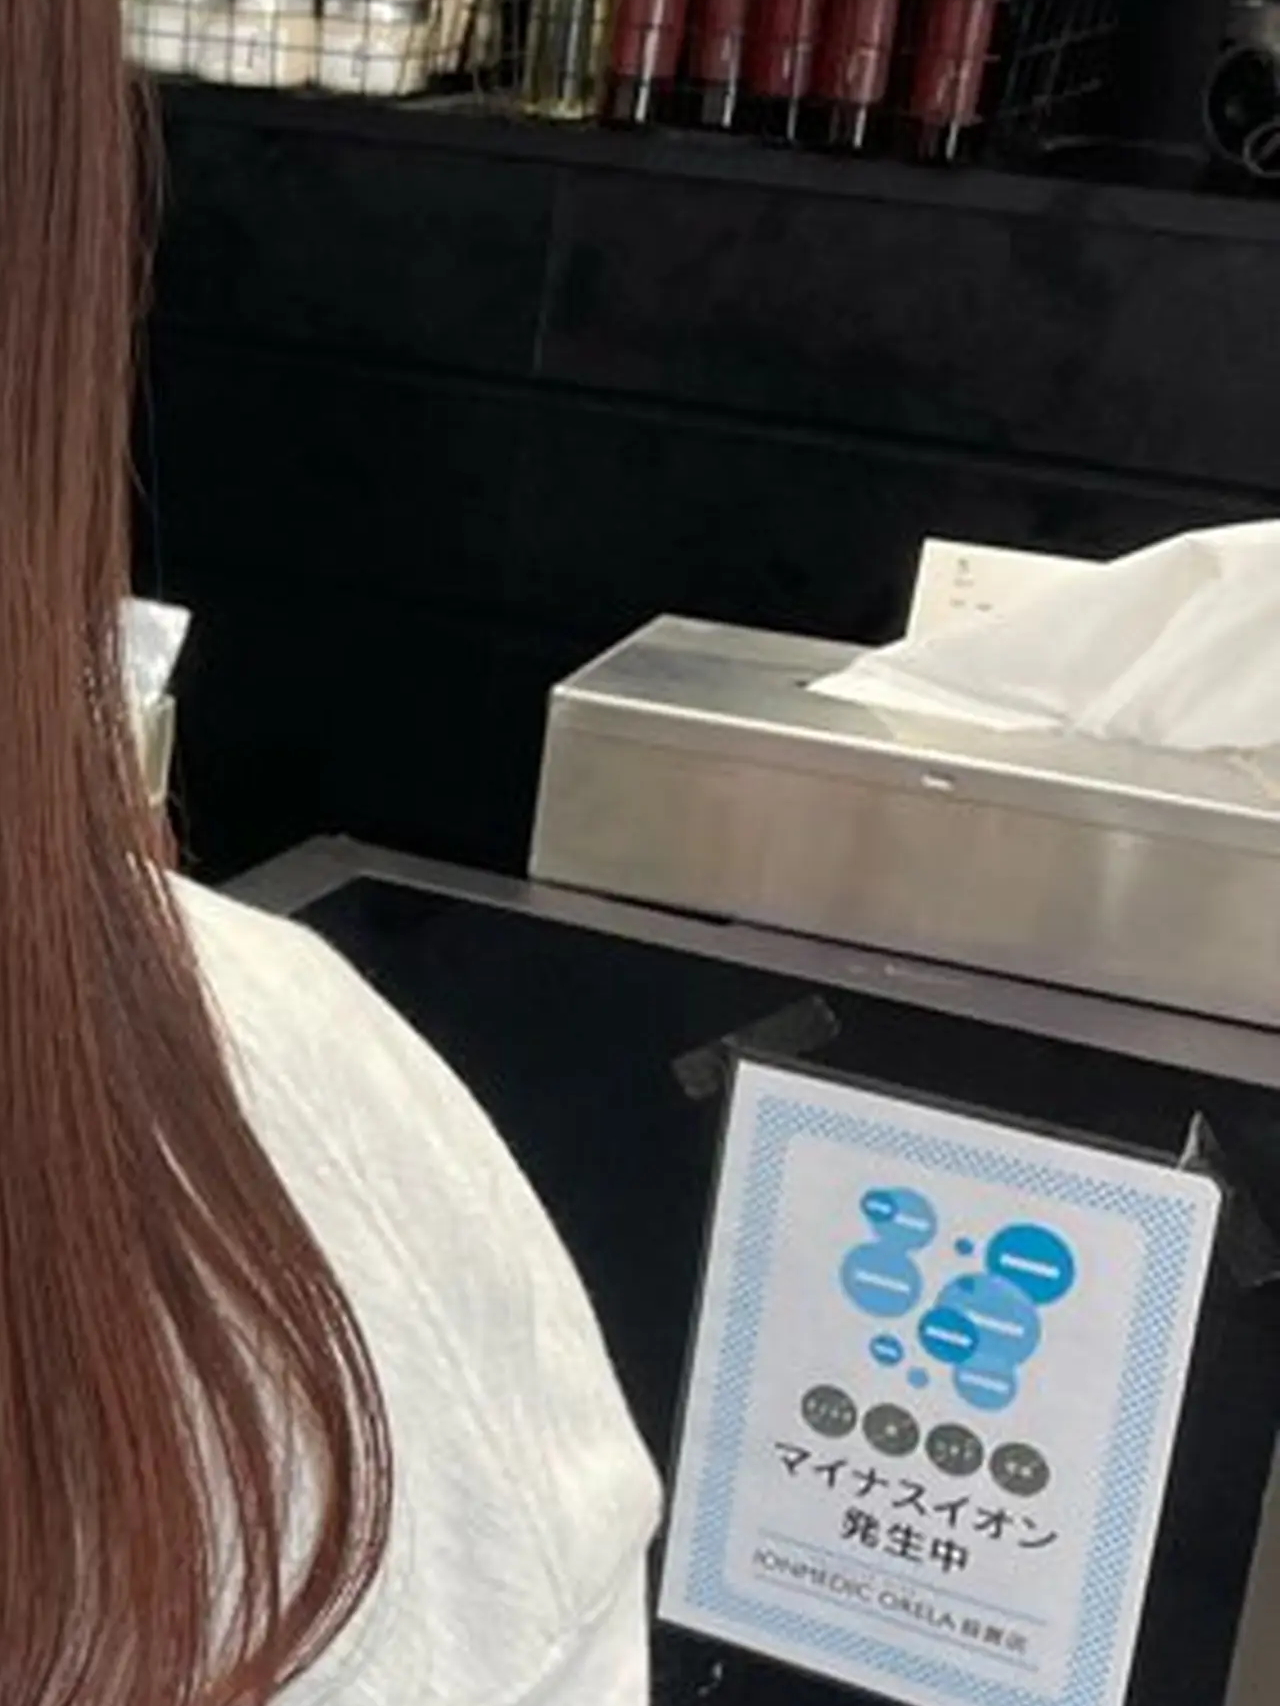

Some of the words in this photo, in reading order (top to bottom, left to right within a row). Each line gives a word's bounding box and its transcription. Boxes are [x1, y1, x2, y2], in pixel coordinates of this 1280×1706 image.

[774, 1440, 1059, 1549] マイナスイオン
[842, 1506, 970, 1573] 発生中
